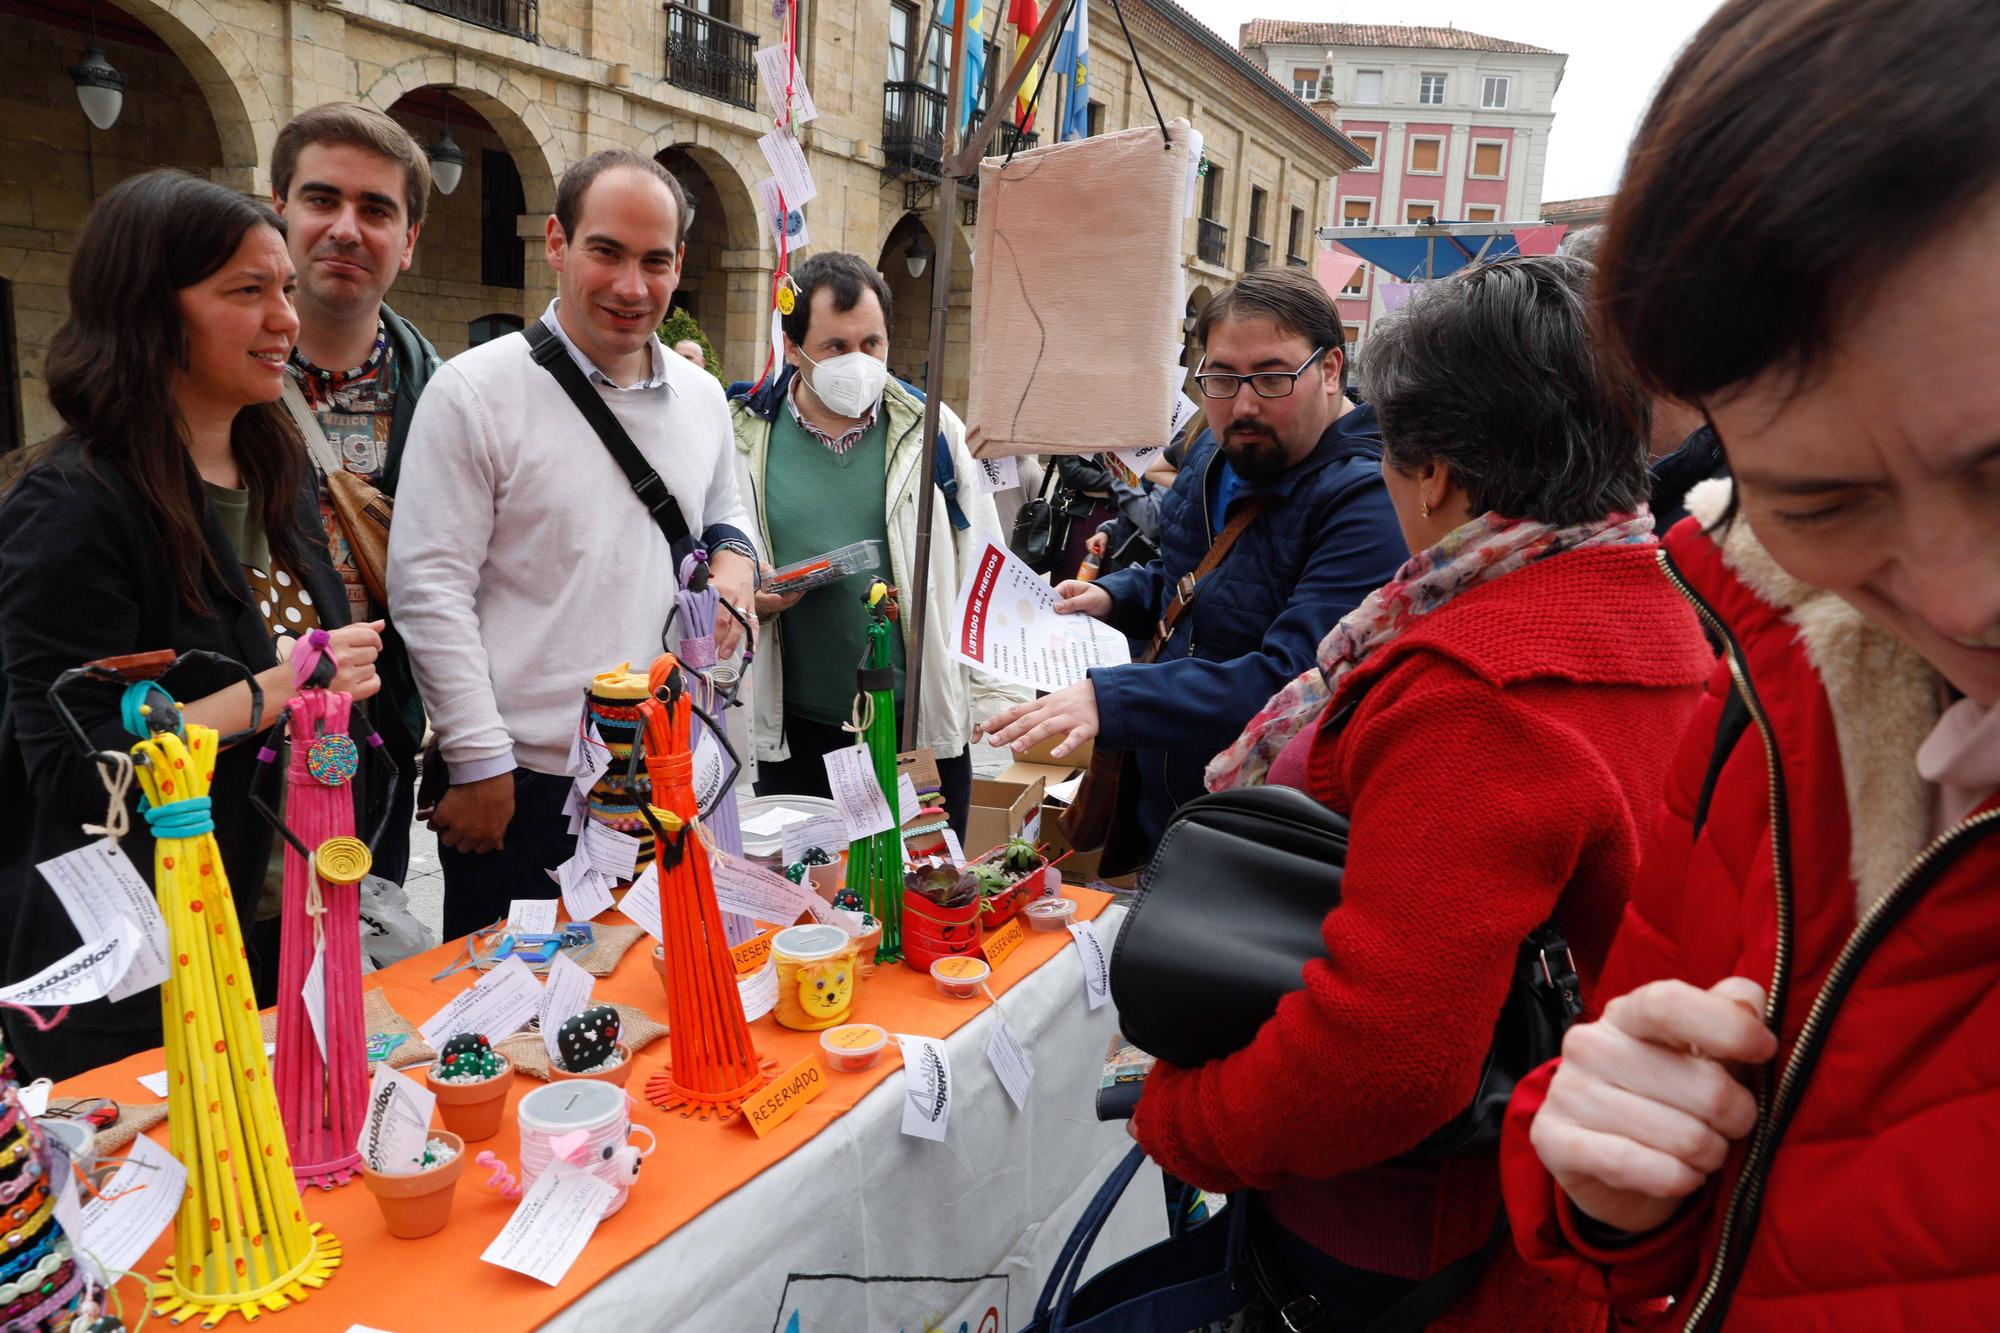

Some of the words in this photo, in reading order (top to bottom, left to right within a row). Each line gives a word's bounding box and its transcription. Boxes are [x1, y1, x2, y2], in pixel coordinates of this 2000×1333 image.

[979, 554, 999, 599] PRECIOS
[972, 598, 983, 614] DE
[968, 614, 980, 656] LISTADO
[697, 753, 721, 809] operativ@
[987, 925, 1022, 961] RESERVADO
[752, 1067, 819, 1125] RESERVADO
[923, 1043, 947, 1122] cooperativ@
